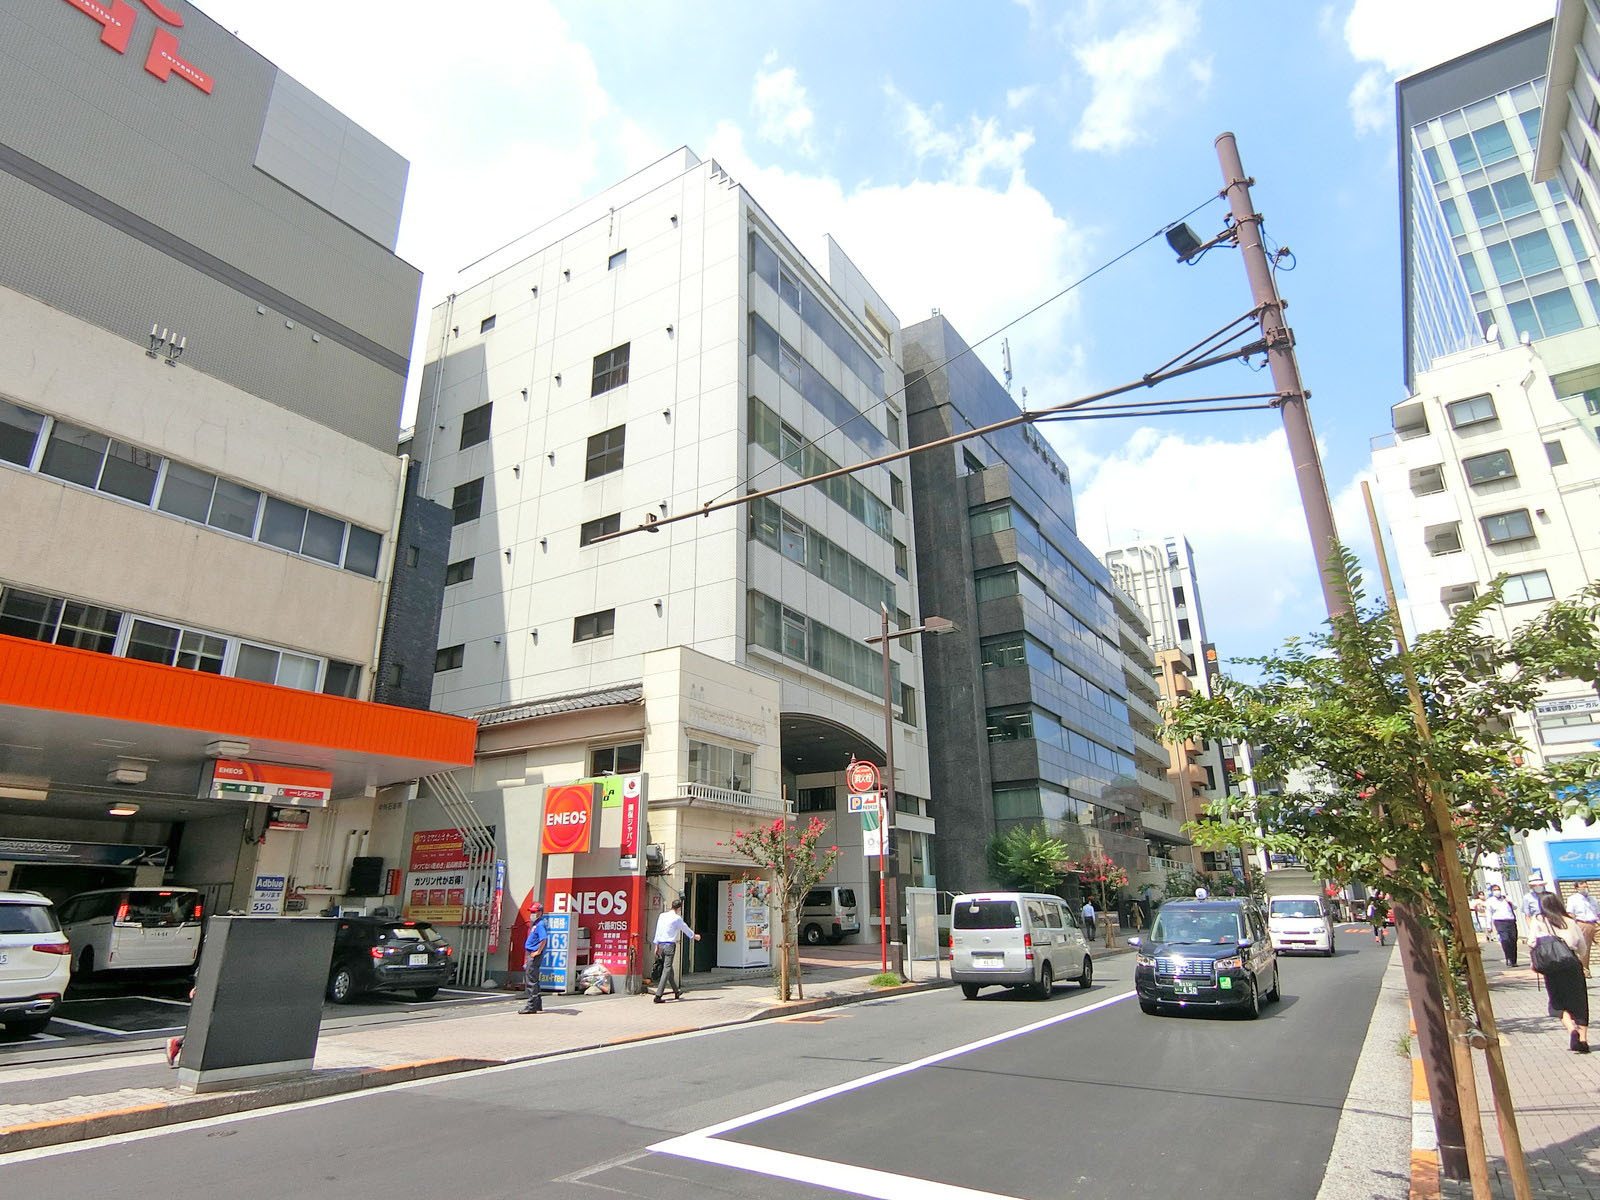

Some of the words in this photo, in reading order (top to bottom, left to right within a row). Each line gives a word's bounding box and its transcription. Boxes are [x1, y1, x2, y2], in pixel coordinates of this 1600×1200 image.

[80, 0, 121, 27] stituto
[218, 767, 244, 775] ENEOS
[546, 810, 587, 826] ENEOS
[257, 879, 284, 888] Adblue
[414, 876, 464, 886] ガソリン代がお得!
[553, 891, 627, 915] ENEOS
[543, 951, 567, 967] 175
